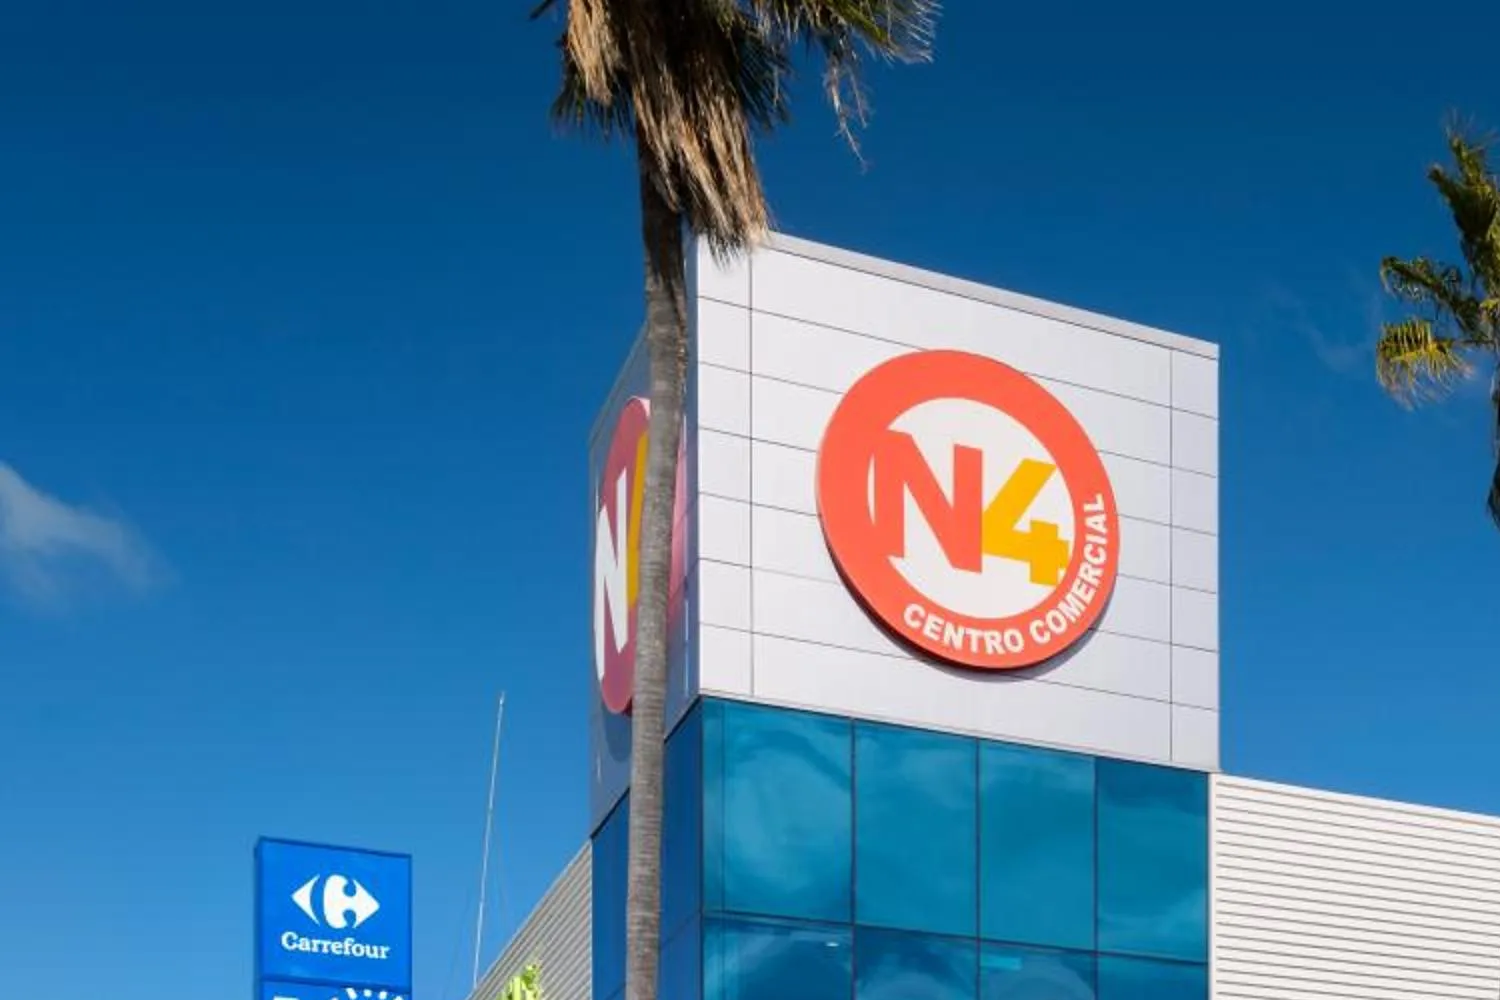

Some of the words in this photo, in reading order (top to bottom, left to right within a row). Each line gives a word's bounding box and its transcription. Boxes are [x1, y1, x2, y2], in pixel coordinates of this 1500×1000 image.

[875, 428, 1070, 586] N4
[903, 603, 1025, 655] CENTRO
[1029, 493, 1108, 645] COMERCIAL
[280, 930, 391, 960] Carrefour
